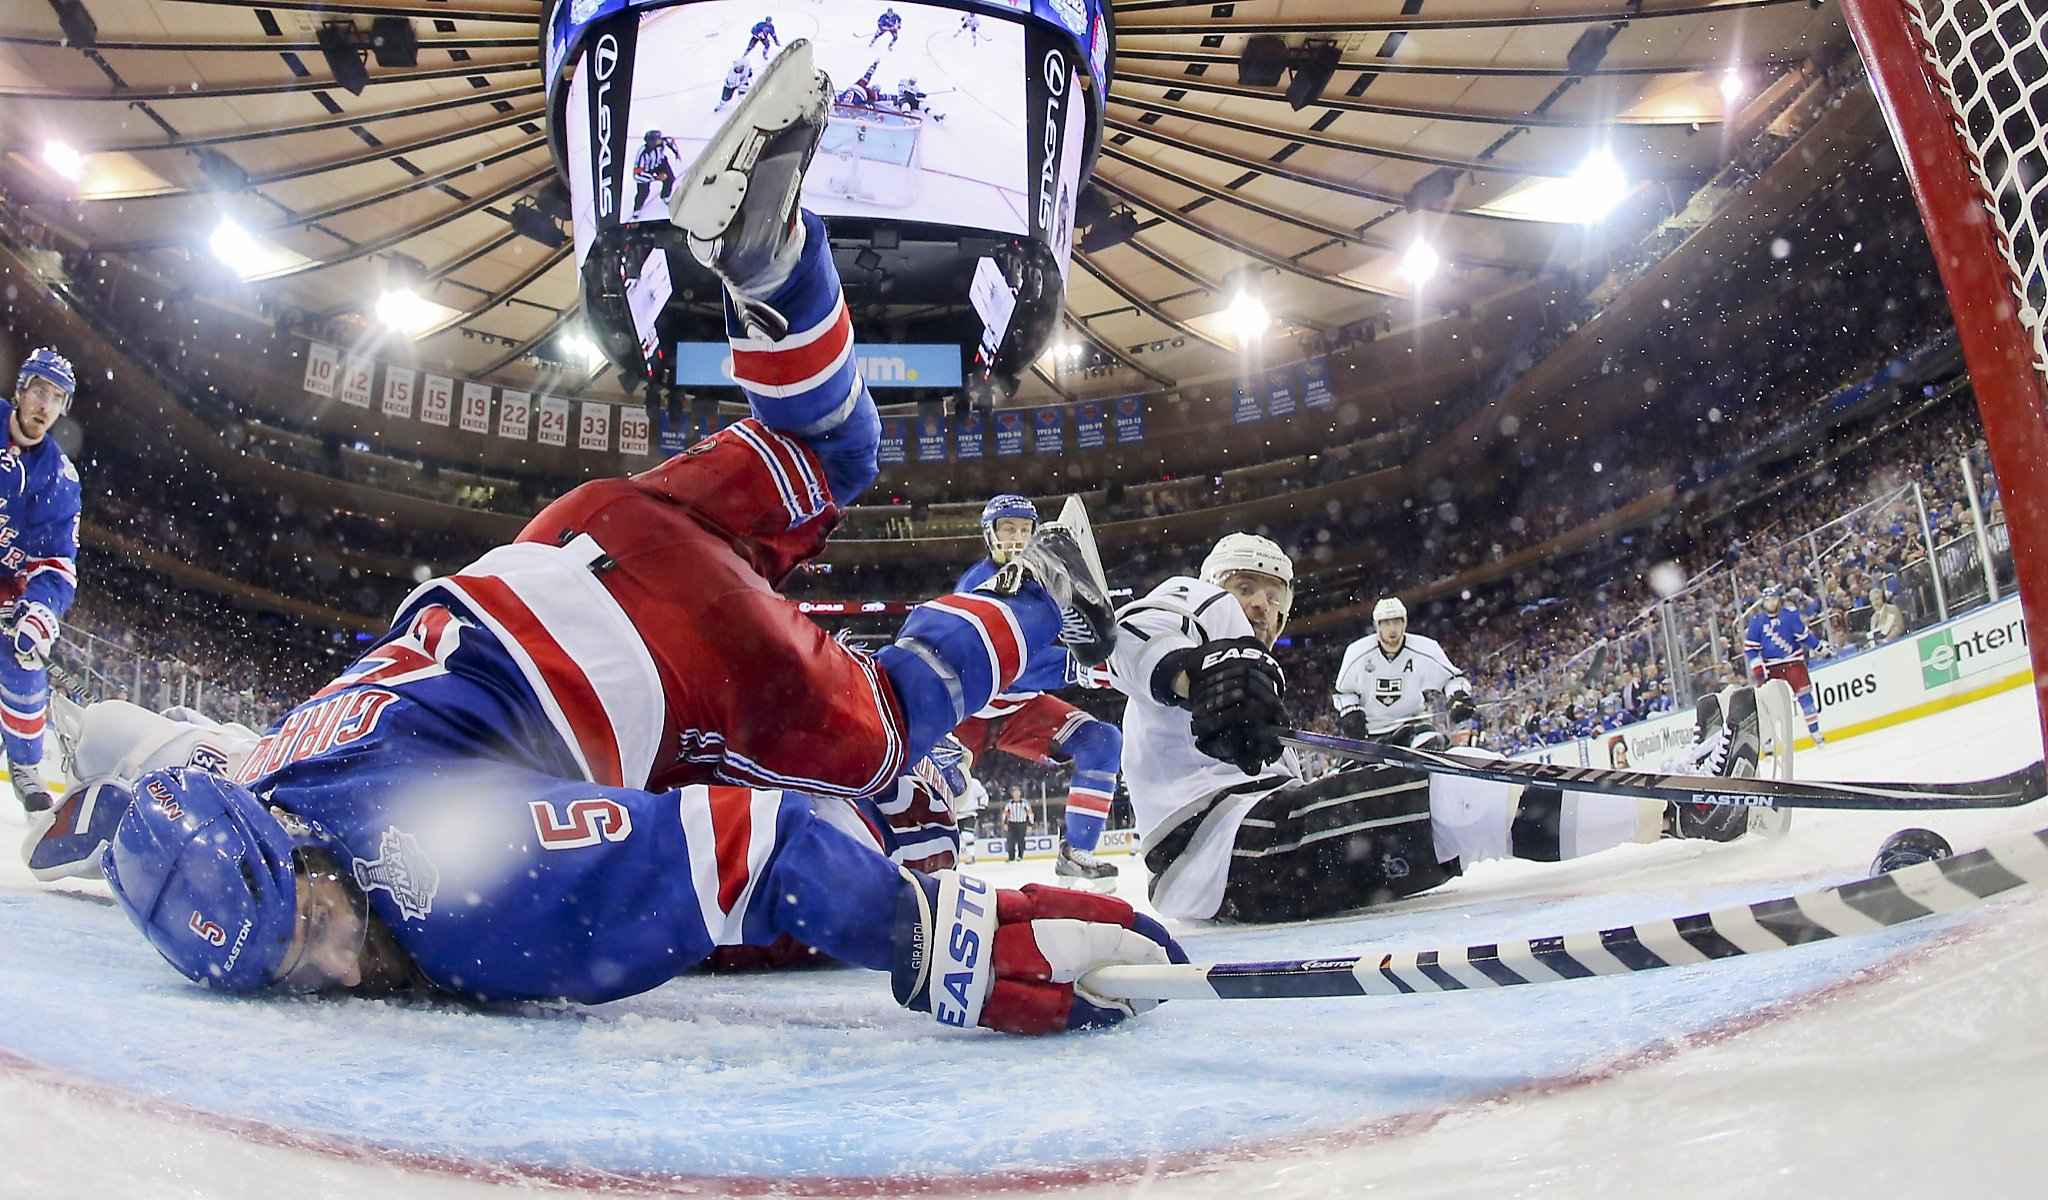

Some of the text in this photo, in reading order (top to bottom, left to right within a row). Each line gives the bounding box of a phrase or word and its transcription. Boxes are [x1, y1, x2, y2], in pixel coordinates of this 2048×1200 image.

[598, 81, 612, 218] LEXUS
[1039, 97, 1059, 231] LEXUS
[312, 358, 330, 379] 10
[388, 381, 408, 401] 15
[427, 389, 447, 410] 15
[466, 398, 485, 417] 19
[503, 405, 526, 424] 22
[542, 411, 564, 431] 24
[583, 417, 607, 436] 33
[621, 421, 648, 439] 613
[1403, 658, 1414, 673] A
[1376, 680, 1402, 692] LA
[1815, 672, 1877, 713] Jones
[146, 780, 185, 822] NYR
[1692, 794, 1774, 806] EASTON
[528, 798, 633, 850] 5
[988, 838, 1052, 853] GCO
[387, 836, 419, 911] FINAL
[189, 910, 227, 947] 5
[224, 919, 253, 972] EASTON
[911, 922, 924, 969] GIRARDI
[1311, 961, 1358, 969] EASTON
